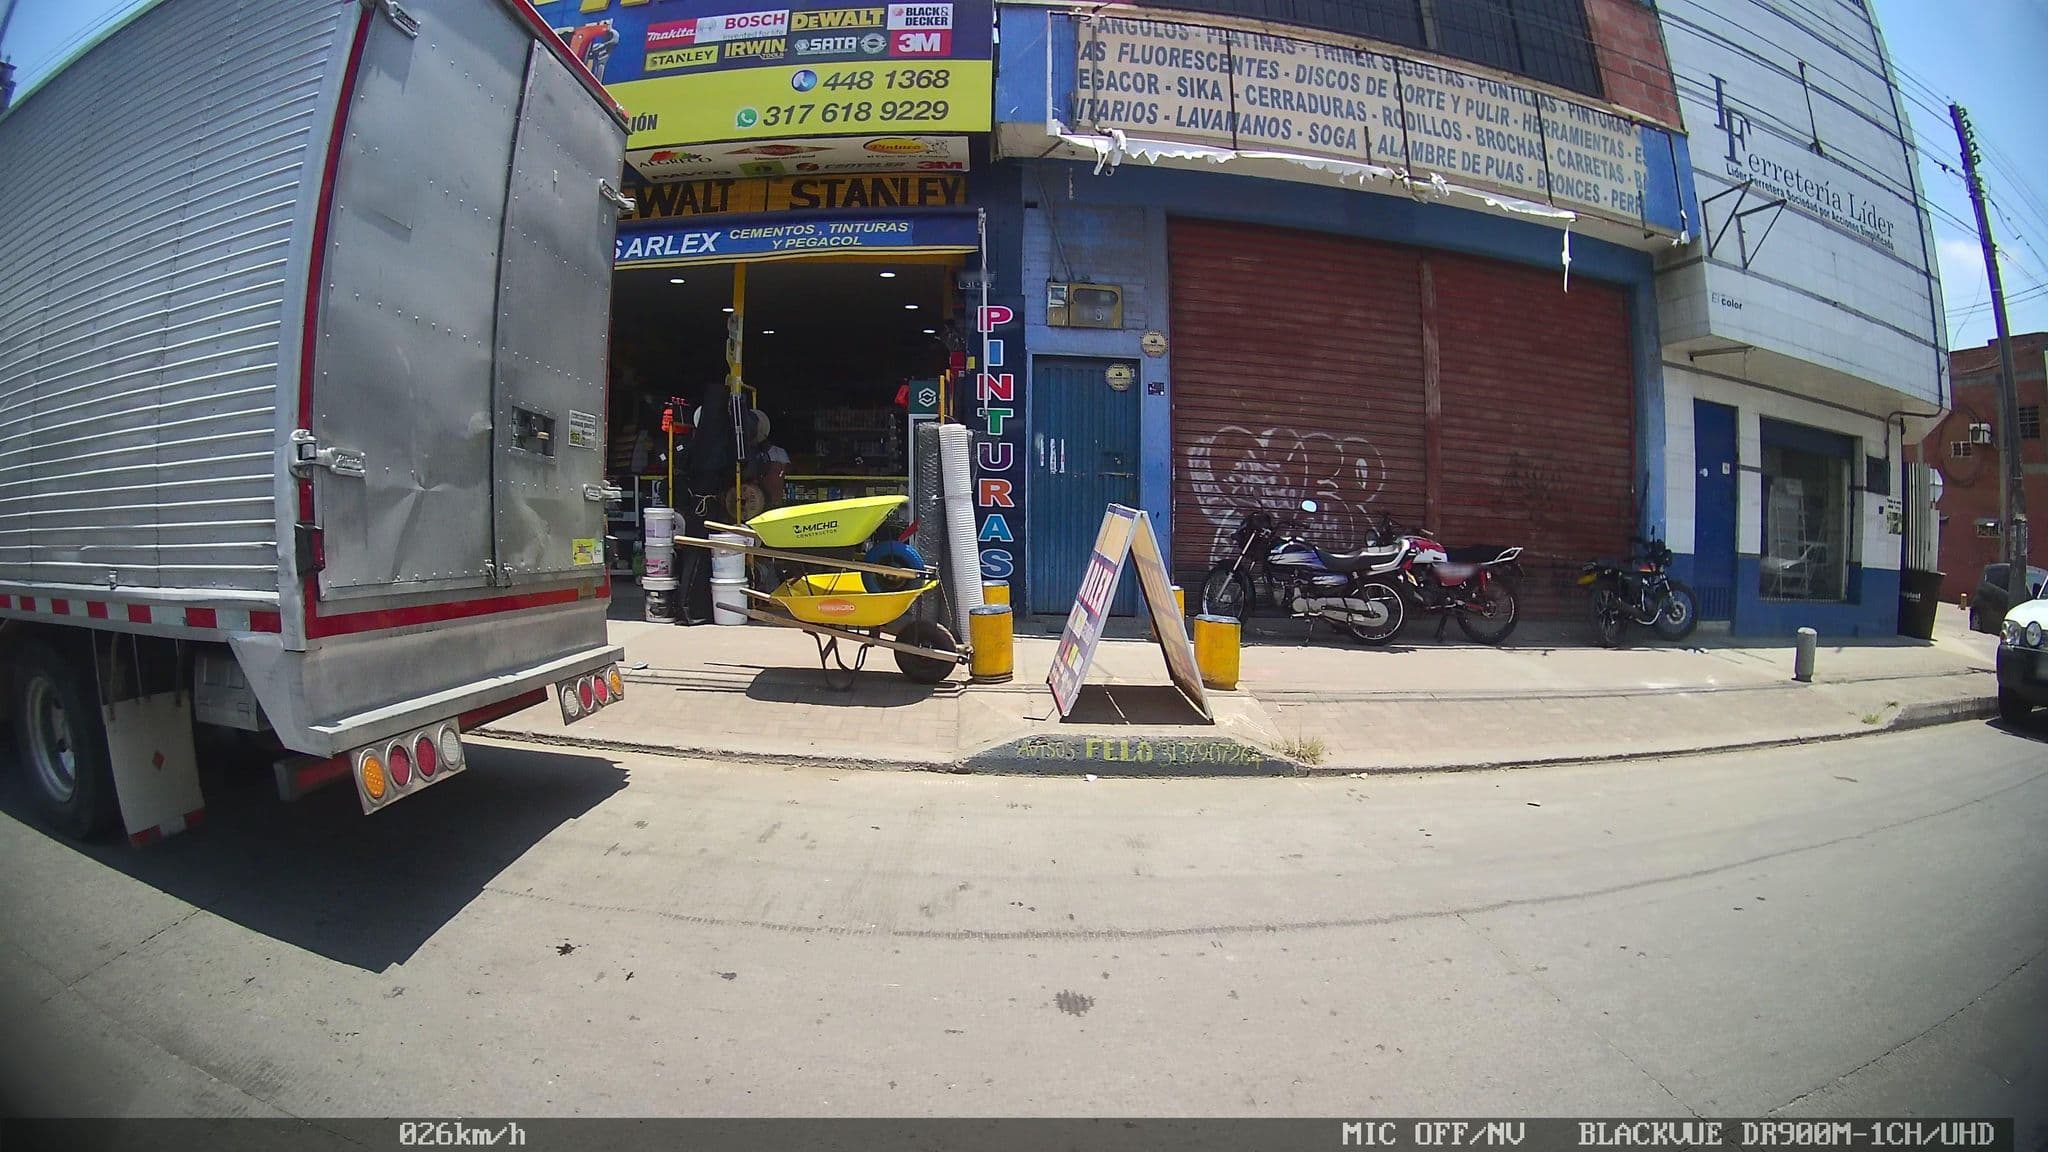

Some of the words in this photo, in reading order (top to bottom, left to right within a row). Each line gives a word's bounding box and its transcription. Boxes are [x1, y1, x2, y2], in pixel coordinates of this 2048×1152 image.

[725, 13, 786, 29] BOSCH
[905, 16, 948, 26] DECKER
[725, 39, 786, 57] IRWIN
[810, 37, 857, 51] SATA
[898, 33, 941, 52] 3M
[651, 50, 713, 65] STANLEY
[823, 71, 874, 91] 448
[885, 69, 950, 90] 1368
[1079, 40, 1107, 62] AS
[1118, 42, 1280, 80] FLUORESCENTES
[1295, 63, 1361, 93] DISCOS
[1366, 76, 1388, 98] DE
[1393, 82, 1446, 111] CORTE
[1451, 93, 1461, 114] Y
[1466, 97, 1510, 127] PULIR
[1523, 112, 1625, 159] HERRAMIENTAS
[631, 112, 658, 132] IÓN
[763, 104, 815, 126] 317
[822, 102, 873, 123] 618
[880, 100, 949, 121] 9229
[1177, 76, 1223, 102] SIKA
[1245, 84, 1367, 122] CERRADURAS
[1382, 105, 1462, 142] RODILLOS
[1475, 126, 1545, 162] BROCHAS
[1557, 146, 1625, 185] CARRETAS
[1077, 97, 1159, 125] ITARIOS
[1176, 105, 1293, 140] LAVAMANOS
[1308, 122, 1357, 150] SOGA
[1378, 134, 1457, 169] ALAMBRE
[1461, 150, 1481, 175] DE
[1486, 155, 1524, 185] PUAS
[1537, 168, 1601, 204] BRONCES
[917, 161, 963, 169] 3M
[631, 179, 736, 219] WALT
[789, 177, 961, 209] STANLEY
[1848, 192, 1895, 238] Líder
[829, 222, 908, 235] TINTURAS
[772, 239, 781, 249] Y
[785, 236, 862, 248] PEGACOL
[976, 306, 1015, 577] PINTURAS
[802, 520, 838, 533] MACHO
[1086, 737, 1153, 762] FELO
